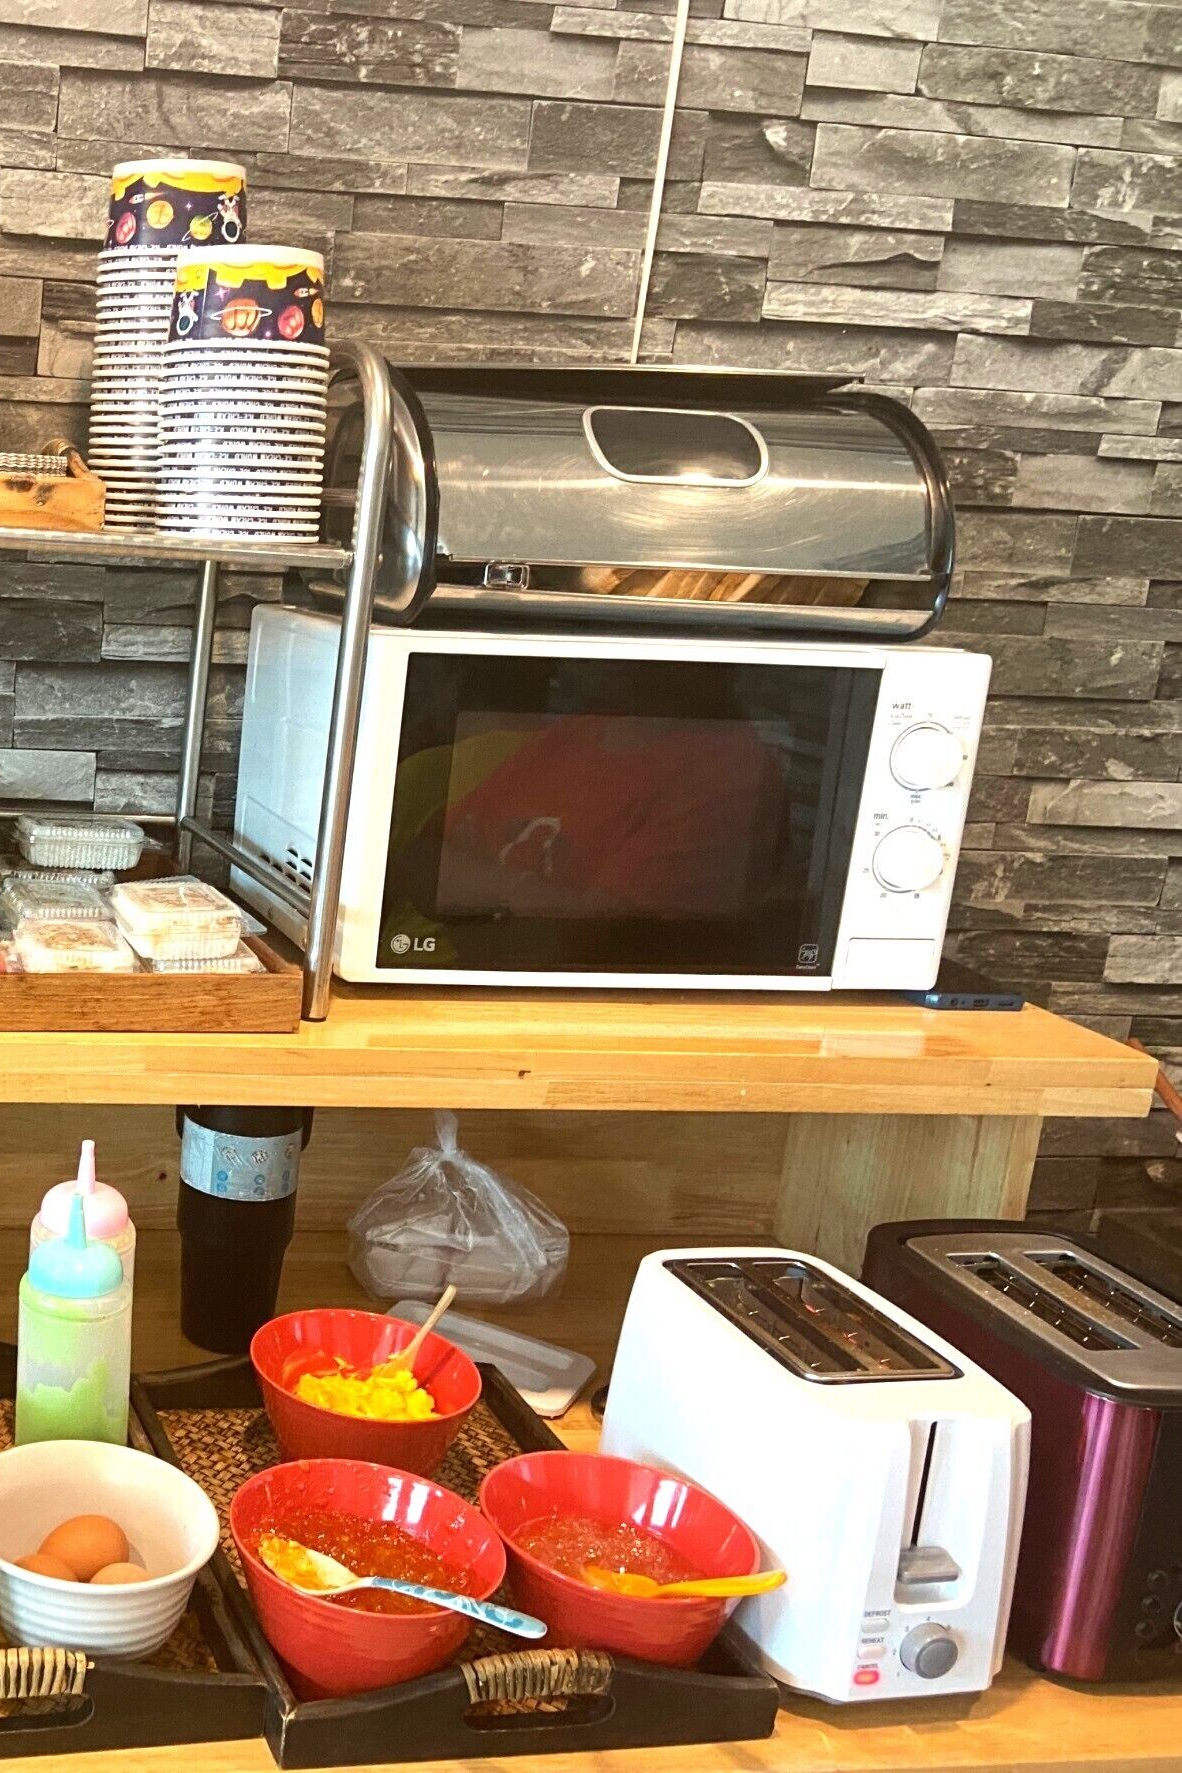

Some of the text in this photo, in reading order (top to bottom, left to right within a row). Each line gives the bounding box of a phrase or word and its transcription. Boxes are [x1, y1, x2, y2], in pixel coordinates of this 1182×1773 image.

[892, 702, 911, 710] watt
[413, 937, 436, 952] LG
[864, 1609, 891, 1617] DEFROST
